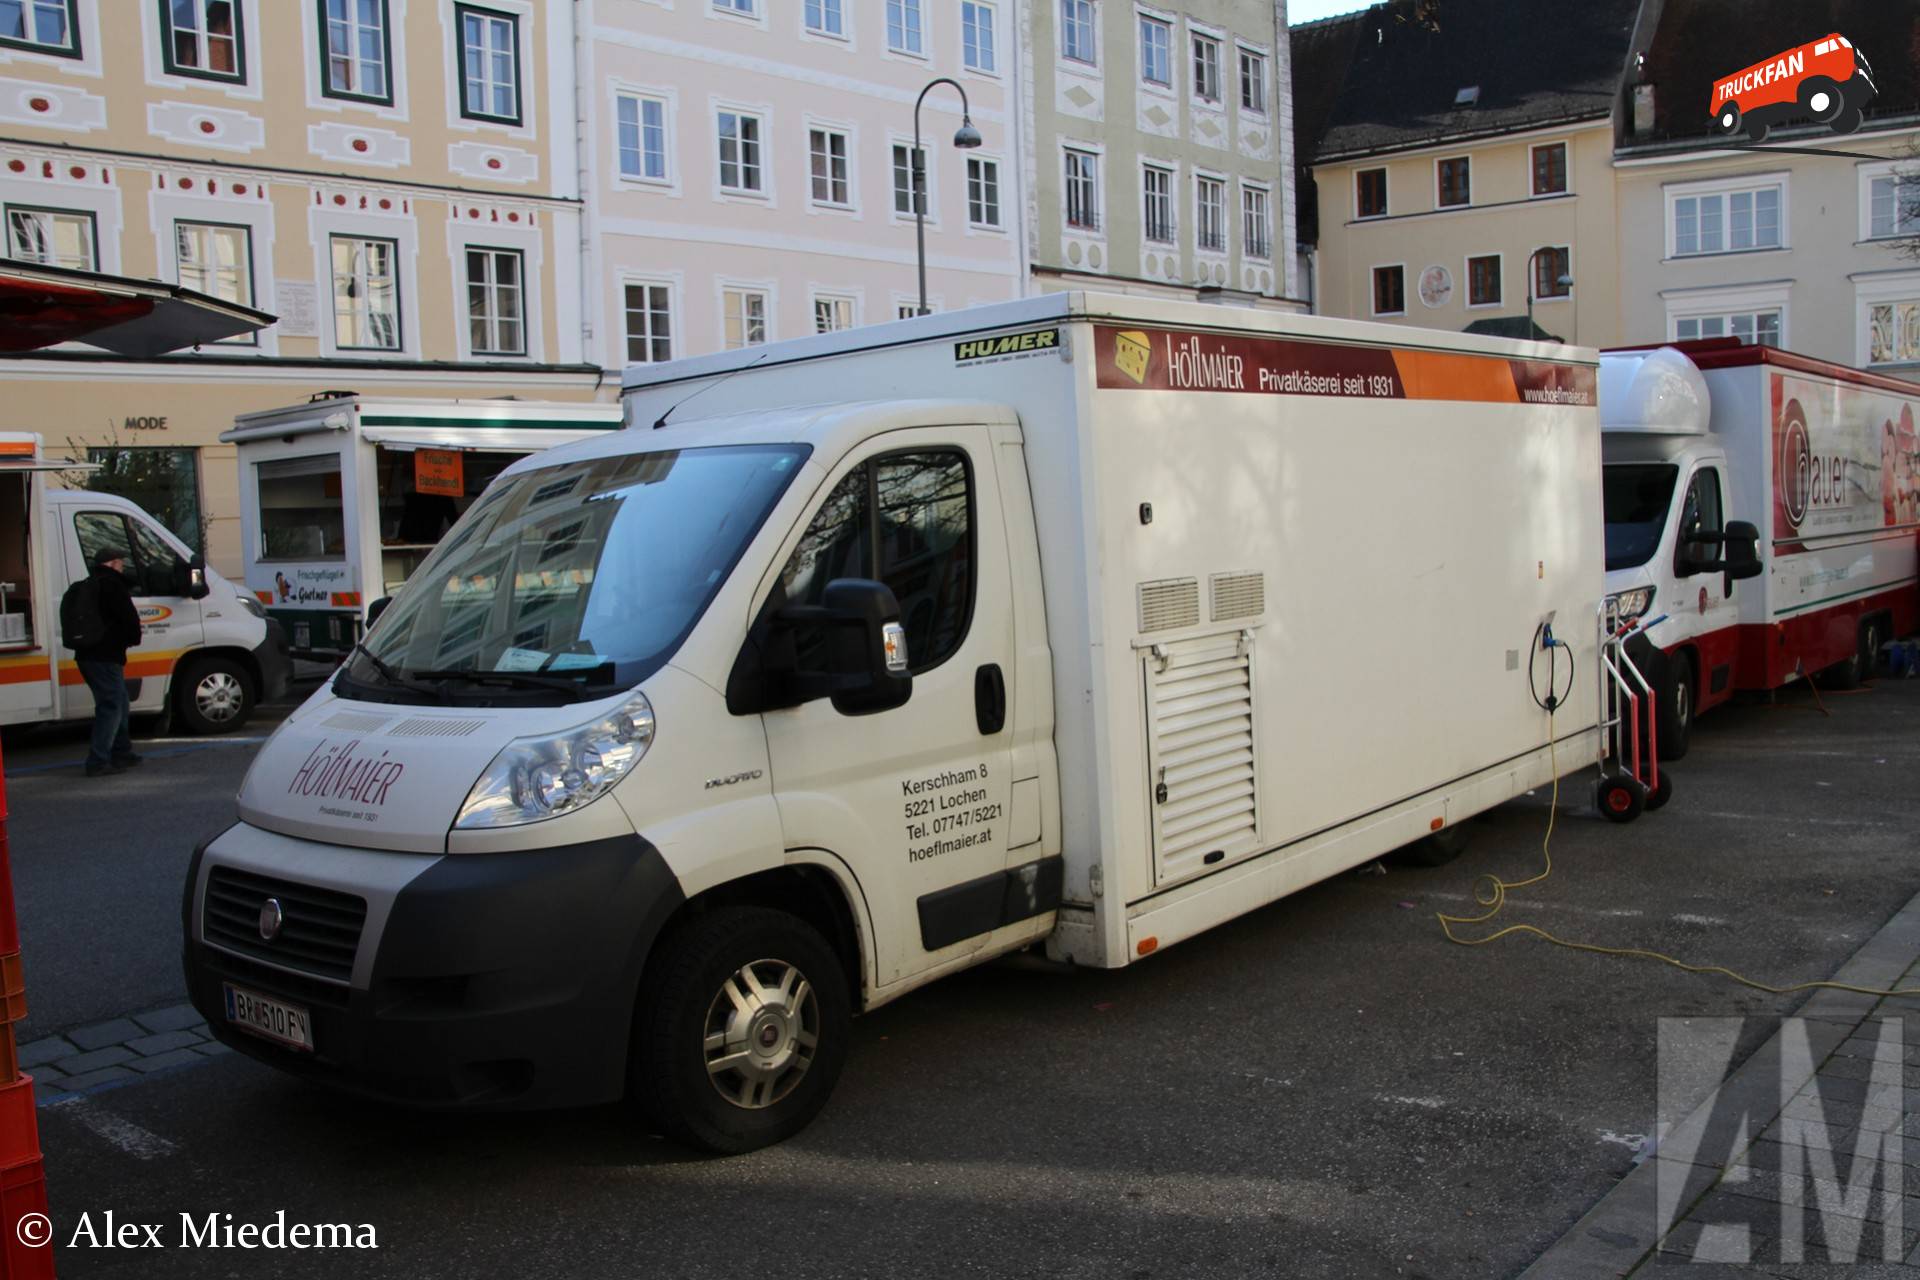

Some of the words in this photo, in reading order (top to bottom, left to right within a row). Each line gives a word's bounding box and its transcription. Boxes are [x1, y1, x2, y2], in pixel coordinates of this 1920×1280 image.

[958, 331, 1056, 359] HUMER
[1258, 368, 1341, 394] Privatkäserei
[1343, 374, 1365, 395] seit
[1367, 376, 1394, 396] 1931
[124, 416, 168, 430] MODE
[902, 769, 977, 796] Kerschham
[979, 763, 989, 778] 8
[904, 798, 935, 818] 5221
[940, 789, 987, 810] Lochen
[906, 822, 930, 840] Tel.
[933, 803, 1002, 834] 07747/5221
[908, 828, 992, 863] hoeflmaier.at
[237, 993, 255, 1023] BR
[262, 1002, 286, 1034] 510
